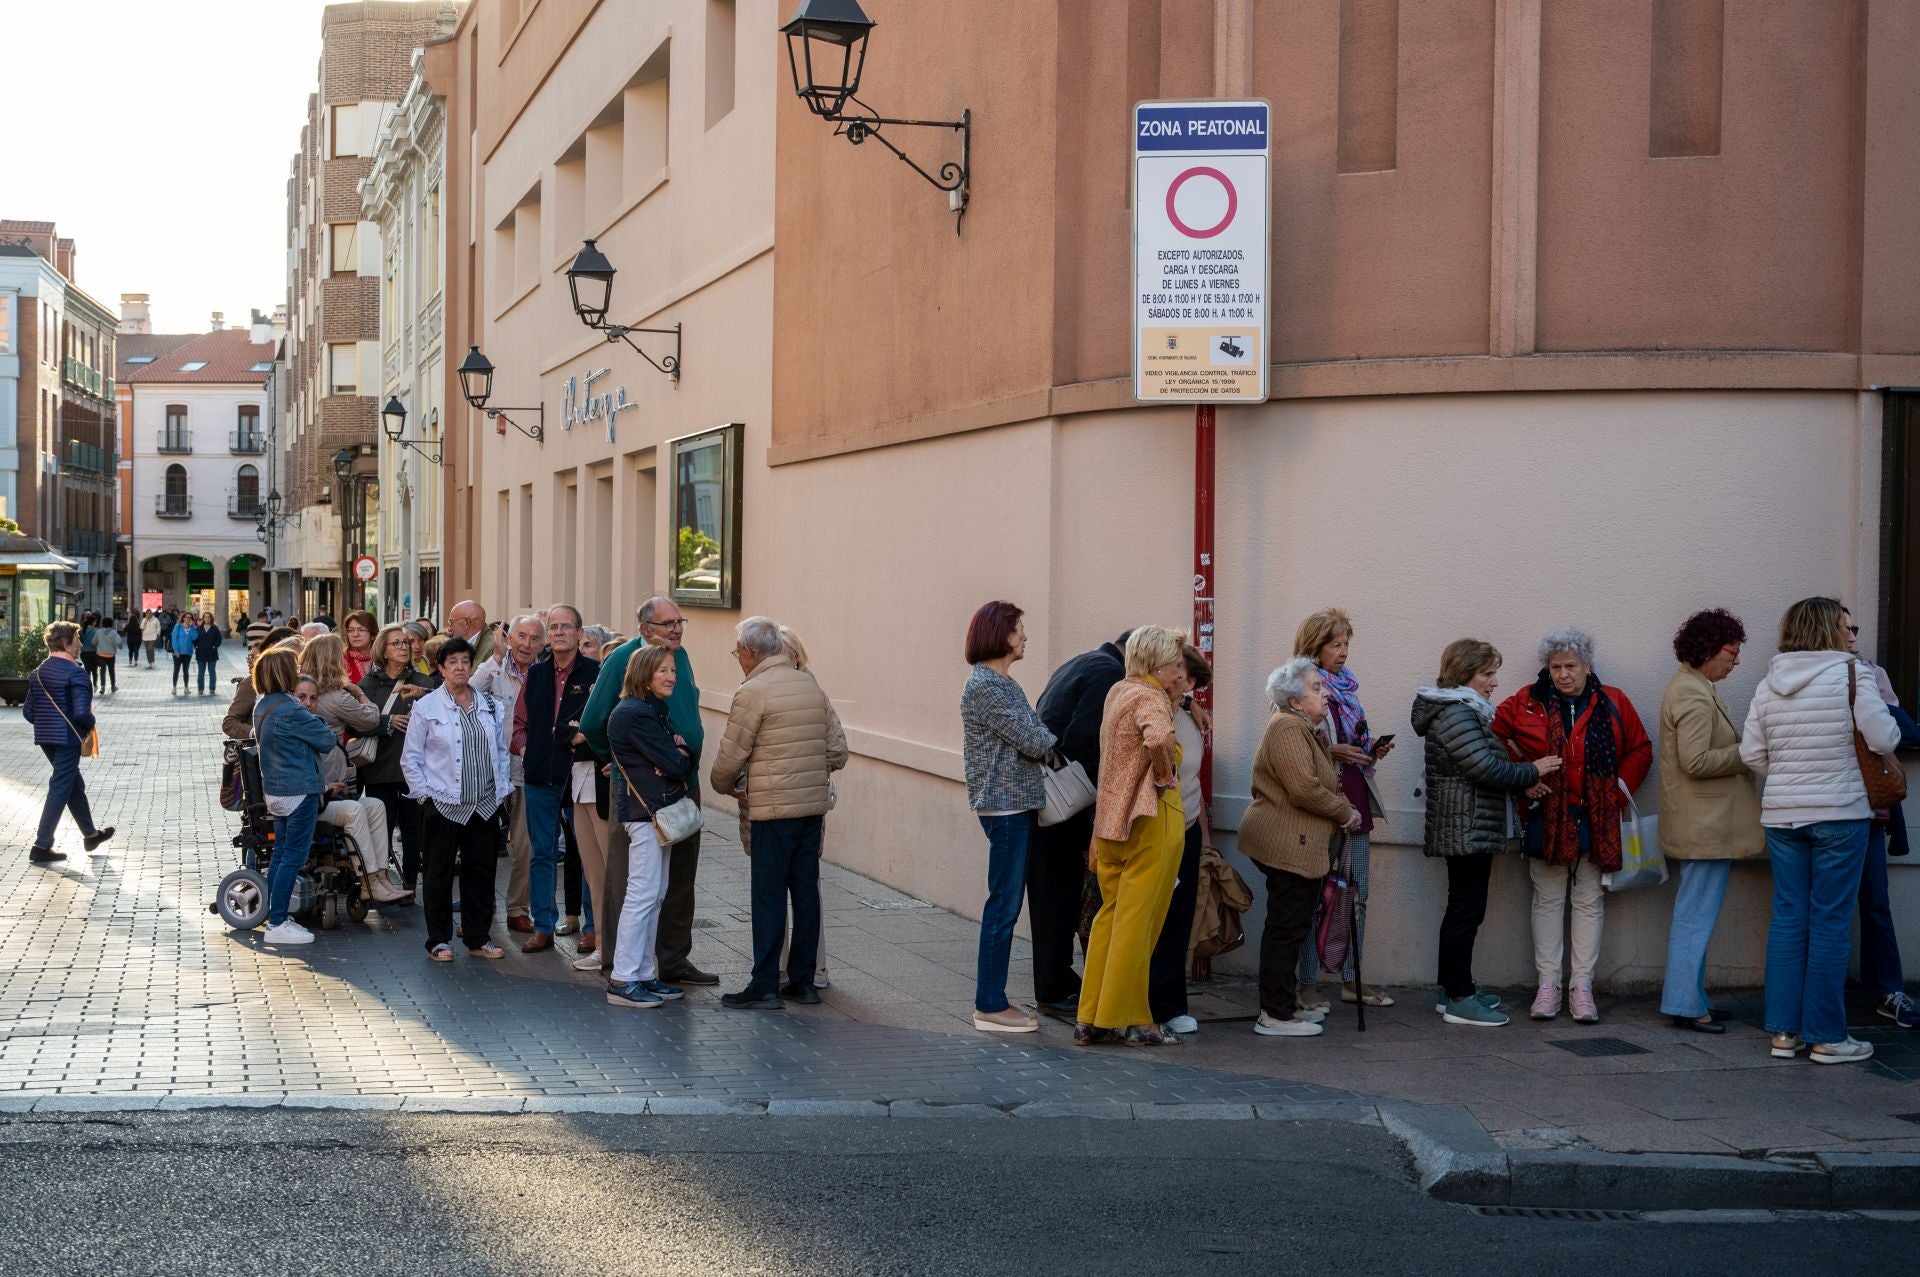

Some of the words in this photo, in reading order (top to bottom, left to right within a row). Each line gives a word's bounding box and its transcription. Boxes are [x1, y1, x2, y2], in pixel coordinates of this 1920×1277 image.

[1140, 121, 1182, 136] ZONA
[1189, 120, 1264, 135] PEATONAL
[1158, 251, 1190, 260] EXCEPTO
[1193, 250, 1245, 261] AUTORIZADOS,
[1164, 265, 1188, 274] CARGA
[1192, 265, 1196, 274] Y
[1199, 265, 1238, 274] DESCARGA
[1163, 280, 1172, 289] DE
[1175, 280, 1198, 289] LUNES
[1201, 280, 1206, 288] A
[1209, 279, 1239, 288] VIERNES
[1143, 295, 1150, 303] DE
[1153, 295, 1166, 303] 8:00
[1168, 295, 1172, 303] A
[1175, 295, 1189, 303] 11:00
[1191, 294, 1195, 303] H
[1197, 294, 1201, 303] Y
[1204, 294, 1212, 303] DE
[1214, 294, 1229, 303] 15:30
[1232, 294, 1236, 303] A
[1239, 294, 1253, 303] 17:00
[1256, 294, 1259, 303] H
[1149, 306, 1180, 318] SÁBADOS
[1183, 309, 1191, 318] DE
[1195, 309, 1209, 318] 8:00
[1213, 309, 1218, 318] H.
[1221, 309, 1226, 317] A
[1229, 308, 1244, 317] 11:00
[1247, 308, 1253, 317] H.
[1231, 369, 1256, 377] TRÁFICO
